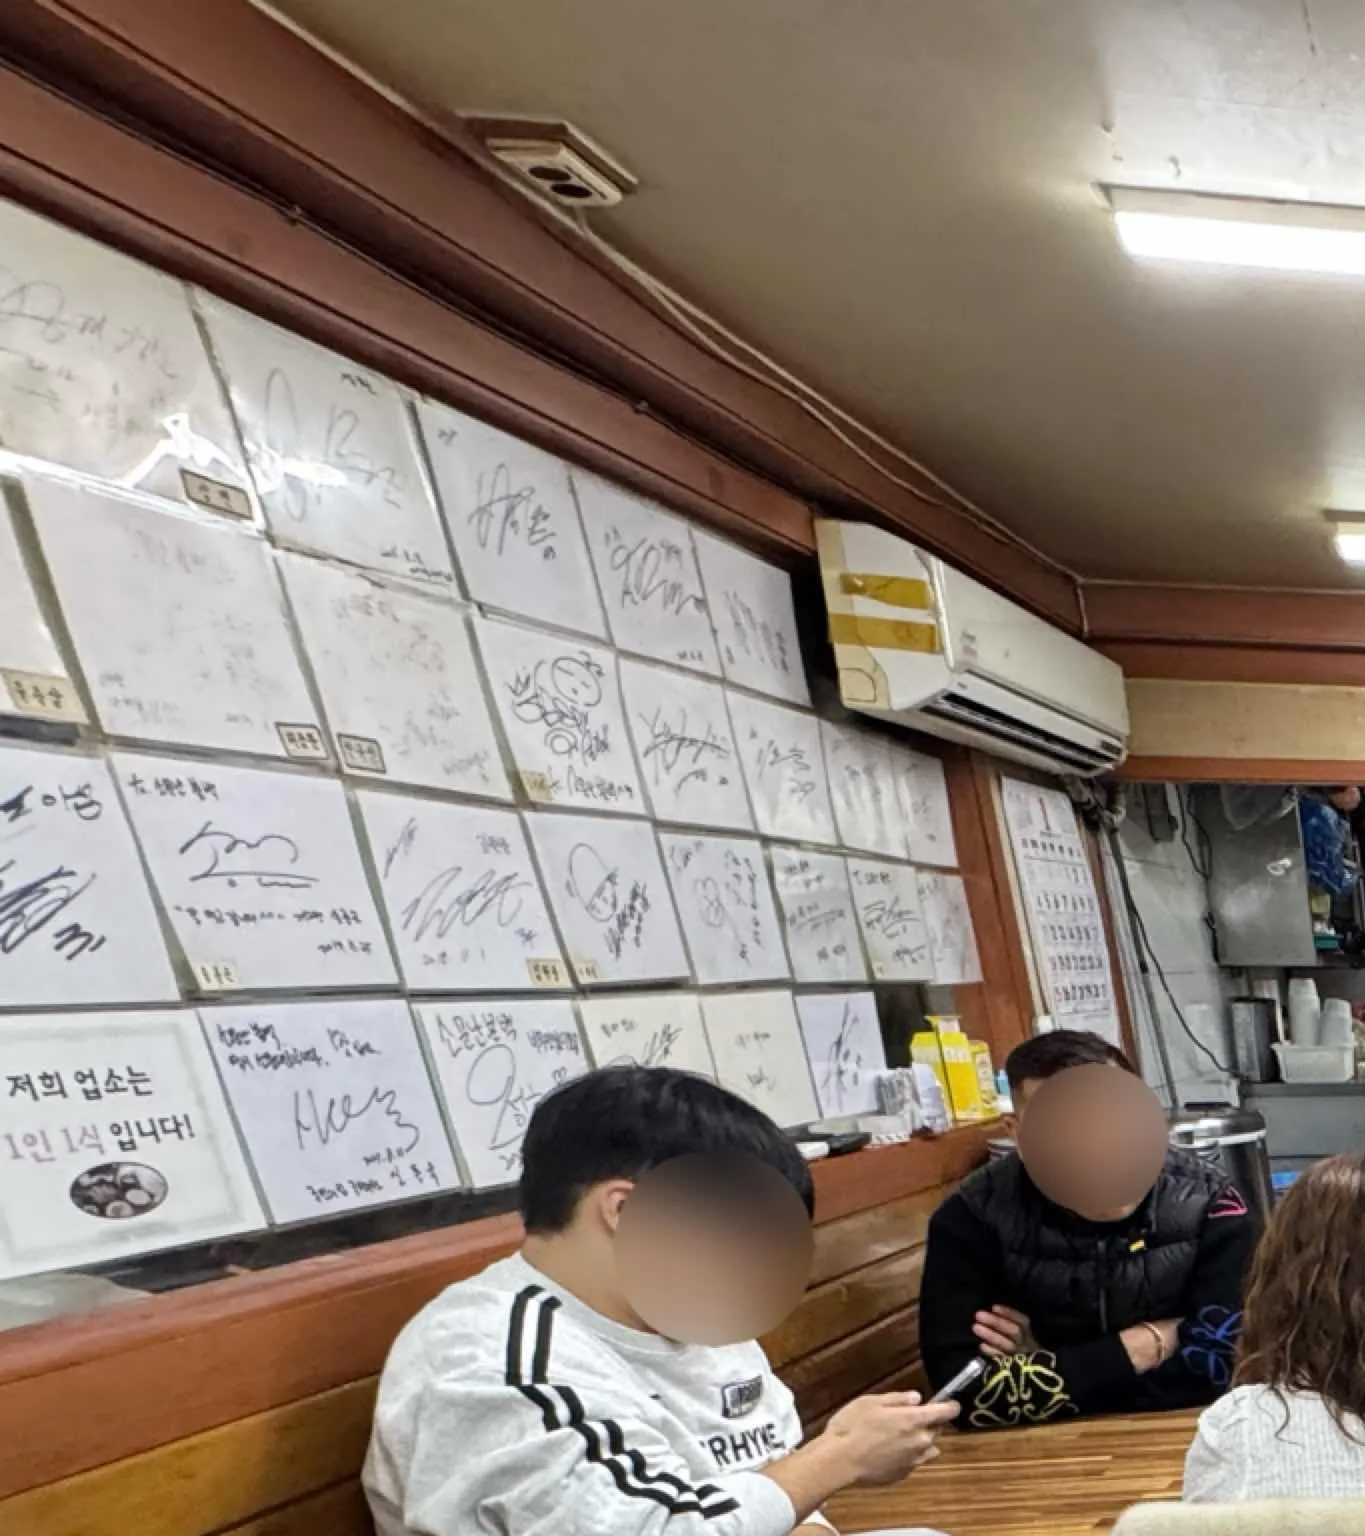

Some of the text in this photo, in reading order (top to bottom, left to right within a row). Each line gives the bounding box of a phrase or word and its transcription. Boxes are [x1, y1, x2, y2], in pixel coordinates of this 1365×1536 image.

[5, 1065, 153, 1102] 저희 업소는
[4, 1129, 56, 1163] 1인
[109, 1112, 196, 1152] 입니다!
